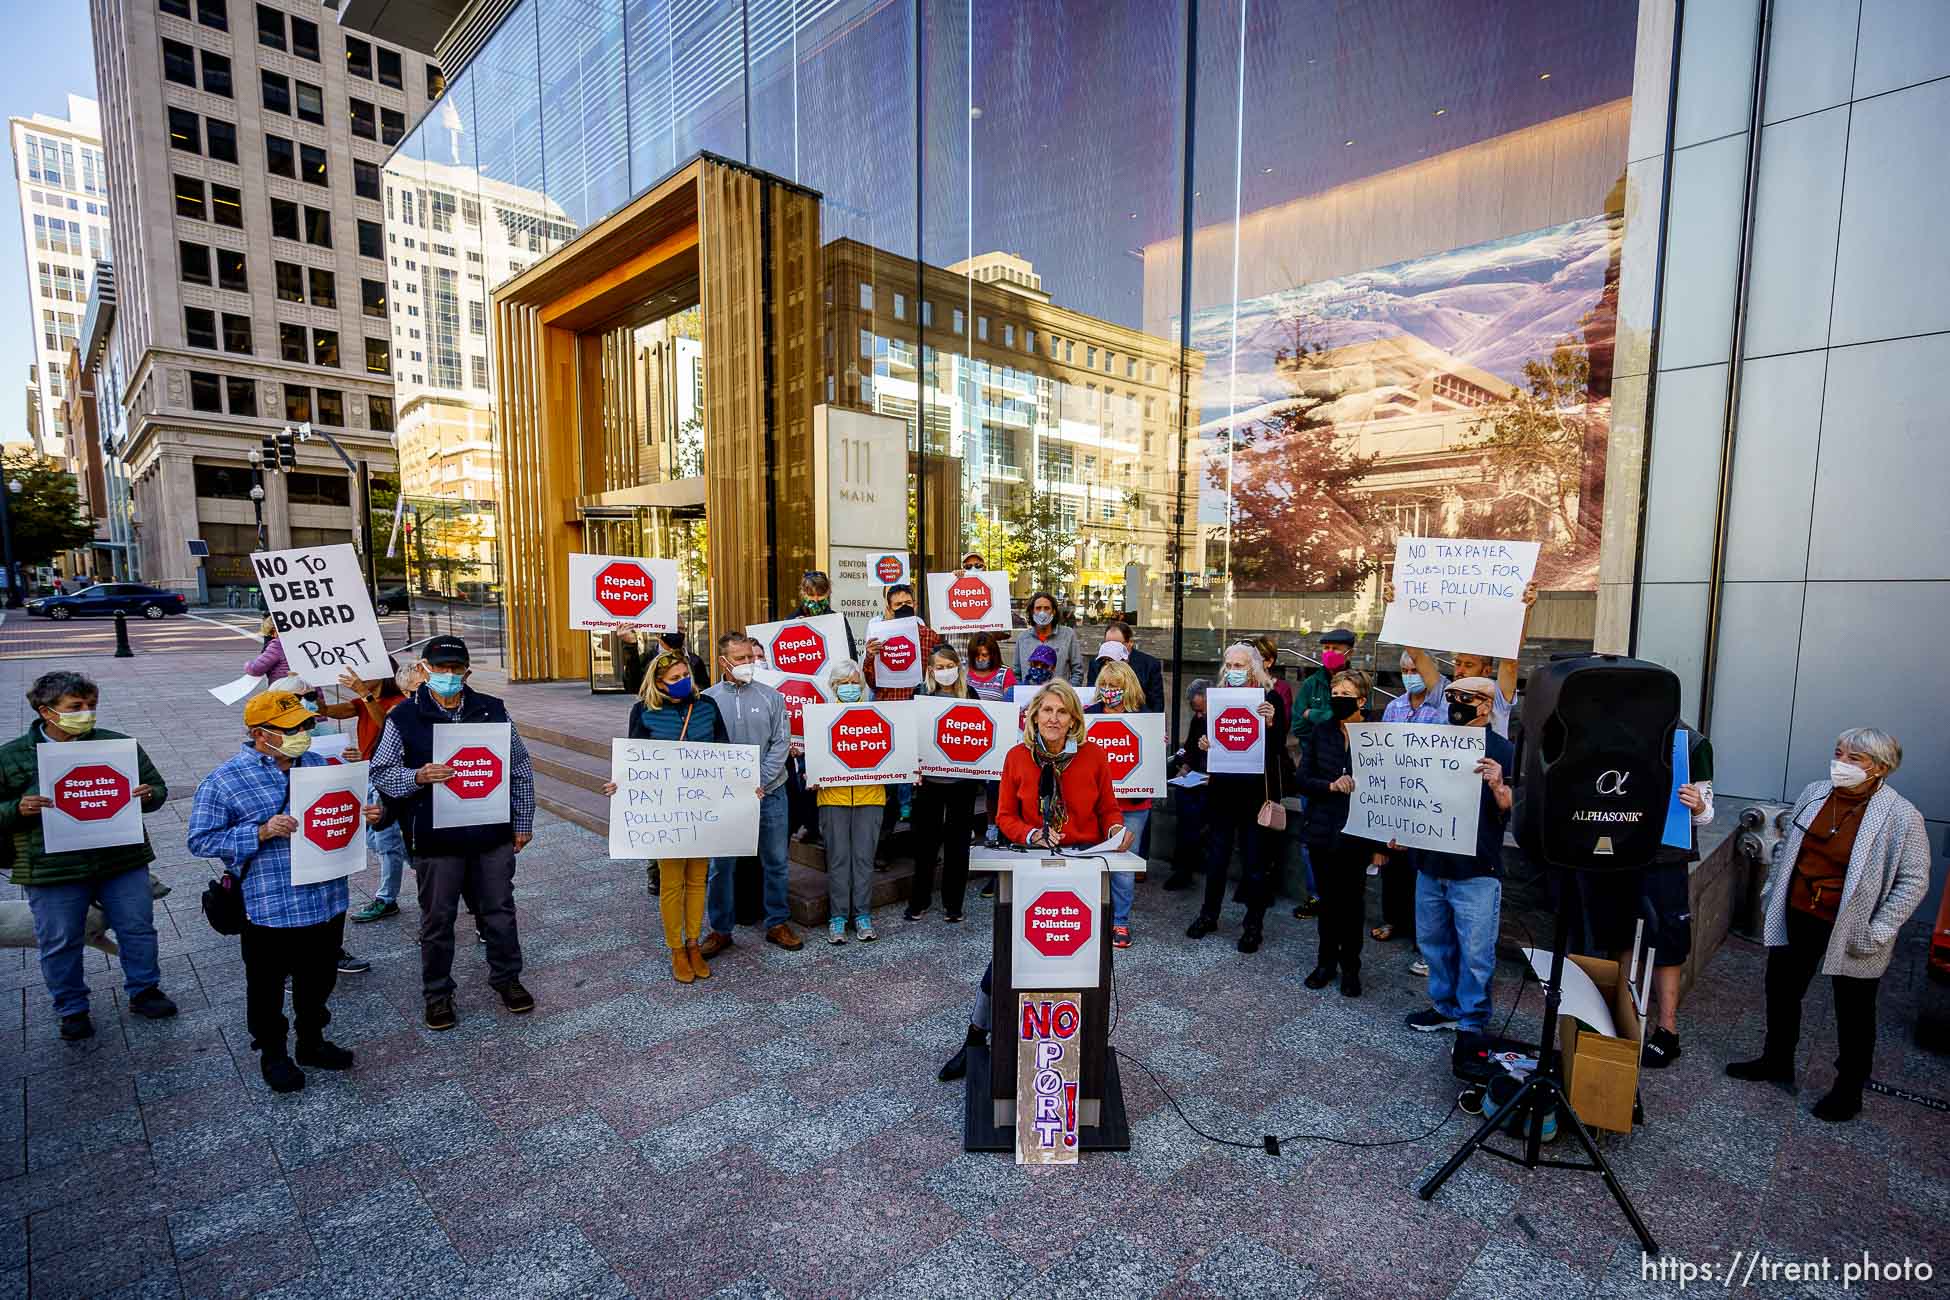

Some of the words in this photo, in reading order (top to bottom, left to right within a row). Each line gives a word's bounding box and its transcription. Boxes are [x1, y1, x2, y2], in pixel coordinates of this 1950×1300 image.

[841, 438, 871, 486] 111
[839, 489, 875, 504] MAIN
[1408, 544, 1426, 559] NO
[1435, 544, 1513, 560] TAXPAYER
[255, 556, 288, 579] NO
[1402, 562, 1482, 577] SUBSIDIES
[1492, 564, 1524, 582] FOR
[604, 575, 646, 588] Repeal
[1403, 579, 1429, 594] THE
[1440, 579, 1514, 598] POLLUTING
[269, 577, 334, 603] DEBT
[600, 589, 621, 600] the
[623, 590, 649, 602] Port
[953, 586, 985, 597] Repeal
[841, 599, 871, 607] DORSEY
[872, 599, 878, 607] &
[952, 599, 968, 608] the
[969, 599, 989, 607] Port
[272, 603, 355, 633] BOARD
[778, 635, 817, 651] Repeal
[298, 638, 371, 669] PORT
[778, 654, 797, 665] the
[798, 650, 822, 662] Port
[945, 718, 986, 732] Repeal
[1220, 717, 1238, 725] Stop
[839, 722, 883, 737] Repeal
[1219, 726, 1252, 734] Polluting
[836, 740, 858, 751] the
[860, 739, 887, 751] Port
[941, 733, 961, 744] the
[963, 735, 989, 747] Port
[1360, 731, 1395, 748] SLC
[1402, 732, 1485, 751] TAXPAYERS
[624, 747, 665, 762] SLC
[672, 747, 754, 762] TAXPAYERS
[1107, 752, 1135, 763] Port
[1395, 752, 1433, 768] WANT
[1440, 758, 1460, 770] TO
[453, 759, 475, 768] Stop
[476, 757, 492, 766] the
[681, 766, 725, 780] WANT
[734, 766, 752, 780] TO
[819, 773, 907, 783] stopthepollutingport.org
[64, 778, 94, 788] Stop
[95, 777, 116, 785] the
[463, 780, 485, 788] Port
[1368, 775, 1386, 790] PAY
[1400, 776, 1429, 794] FOR
[63, 788, 119, 799] Polluting
[628, 787, 663, 807] PAY
[677, 786, 713, 804] FOR
[722, 784, 736, 801] A
[79, 800, 108, 809] Port
[314, 806, 339, 816] Stop
[340, 803, 353, 812] the
[1359, 791, 1443, 814] CALIFORNIA'S
[312, 814, 354, 828] Polluting
[624, 809, 719, 828] POLLUTING
[326, 827, 347, 838] Port
[1034, 906, 1059, 918] Stop
[1061, 906, 1080, 916] the
[1032, 919, 1081, 931] Polluting
[1045, 932, 1070, 942] Port
[1020, 1000, 1081, 1041] NO
